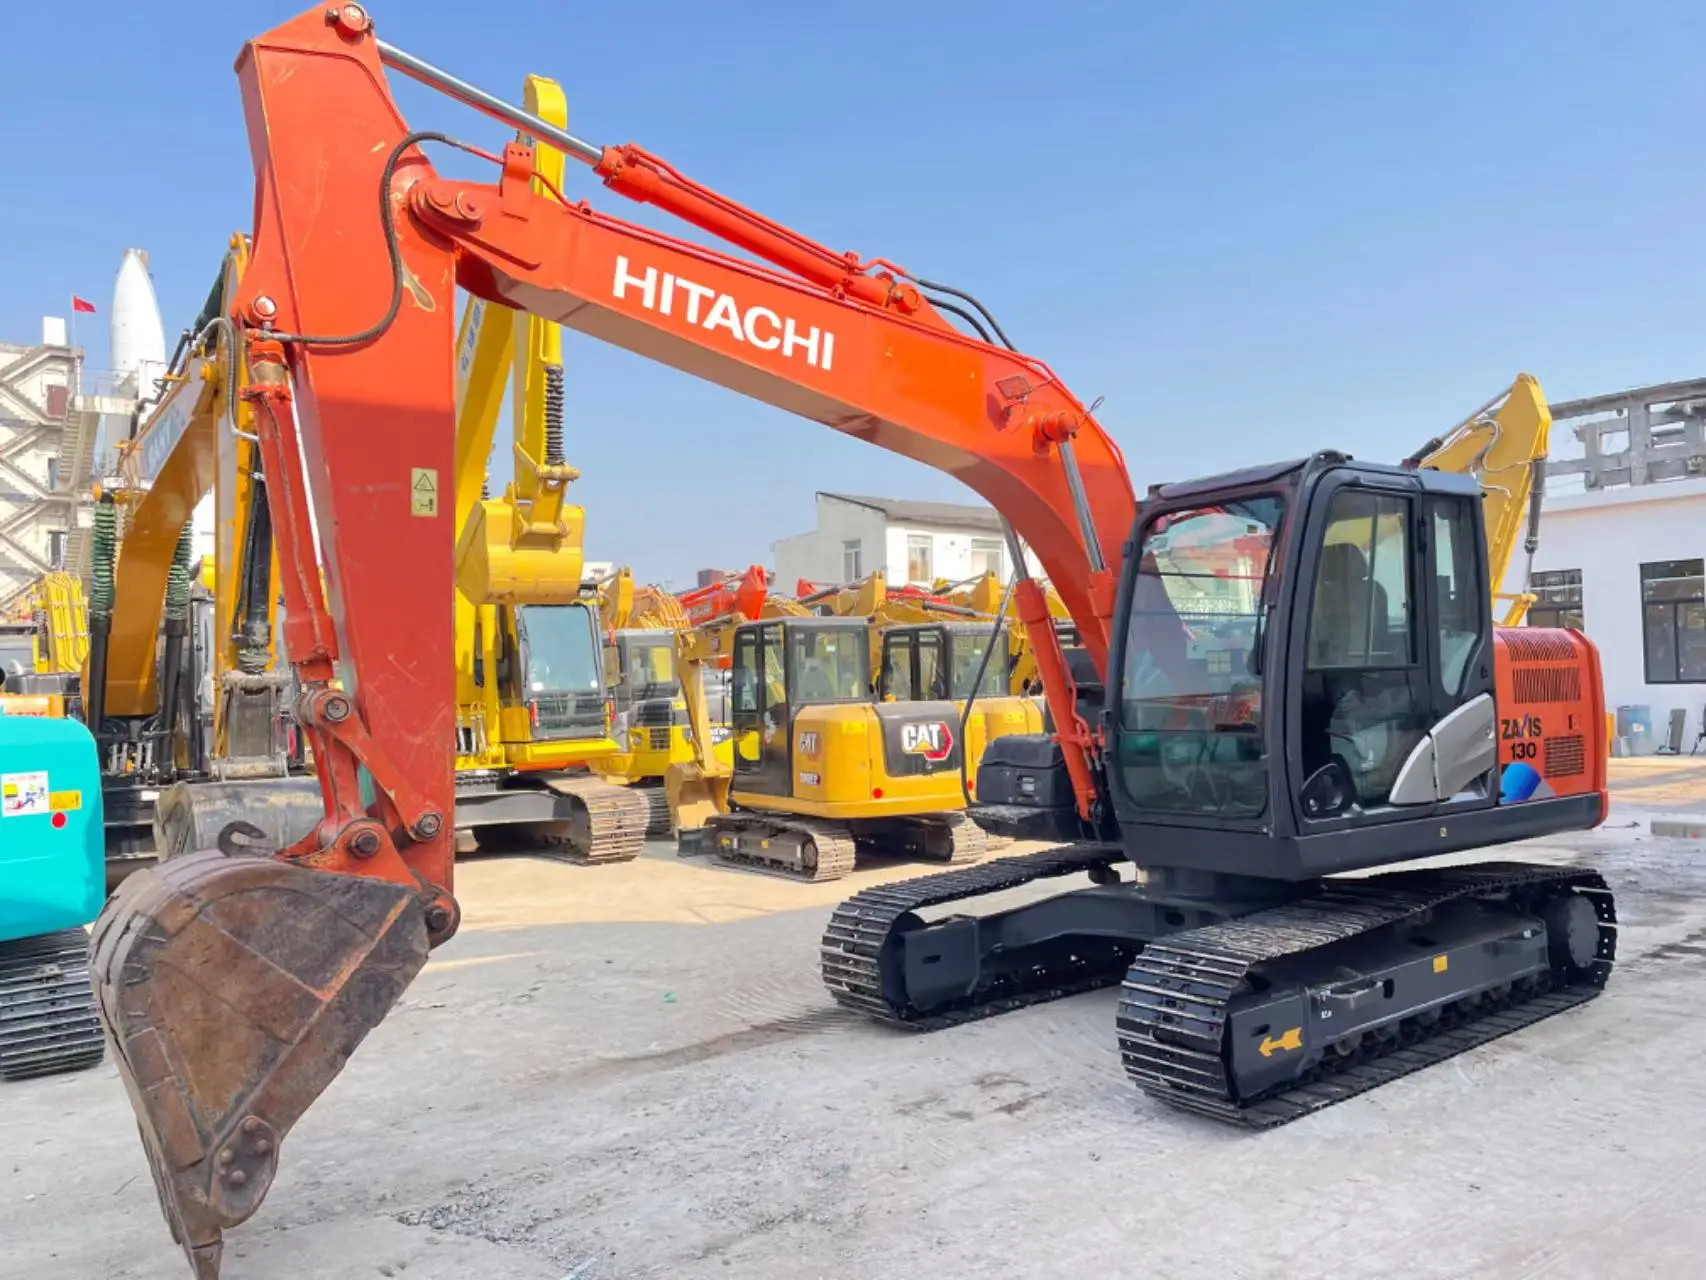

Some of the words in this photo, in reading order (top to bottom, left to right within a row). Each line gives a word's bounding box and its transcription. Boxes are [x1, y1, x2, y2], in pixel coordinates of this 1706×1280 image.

[612, 255, 835, 371] HITACHI
[902, 723, 940, 752] CAT
[1511, 742, 1537, 760] 130
